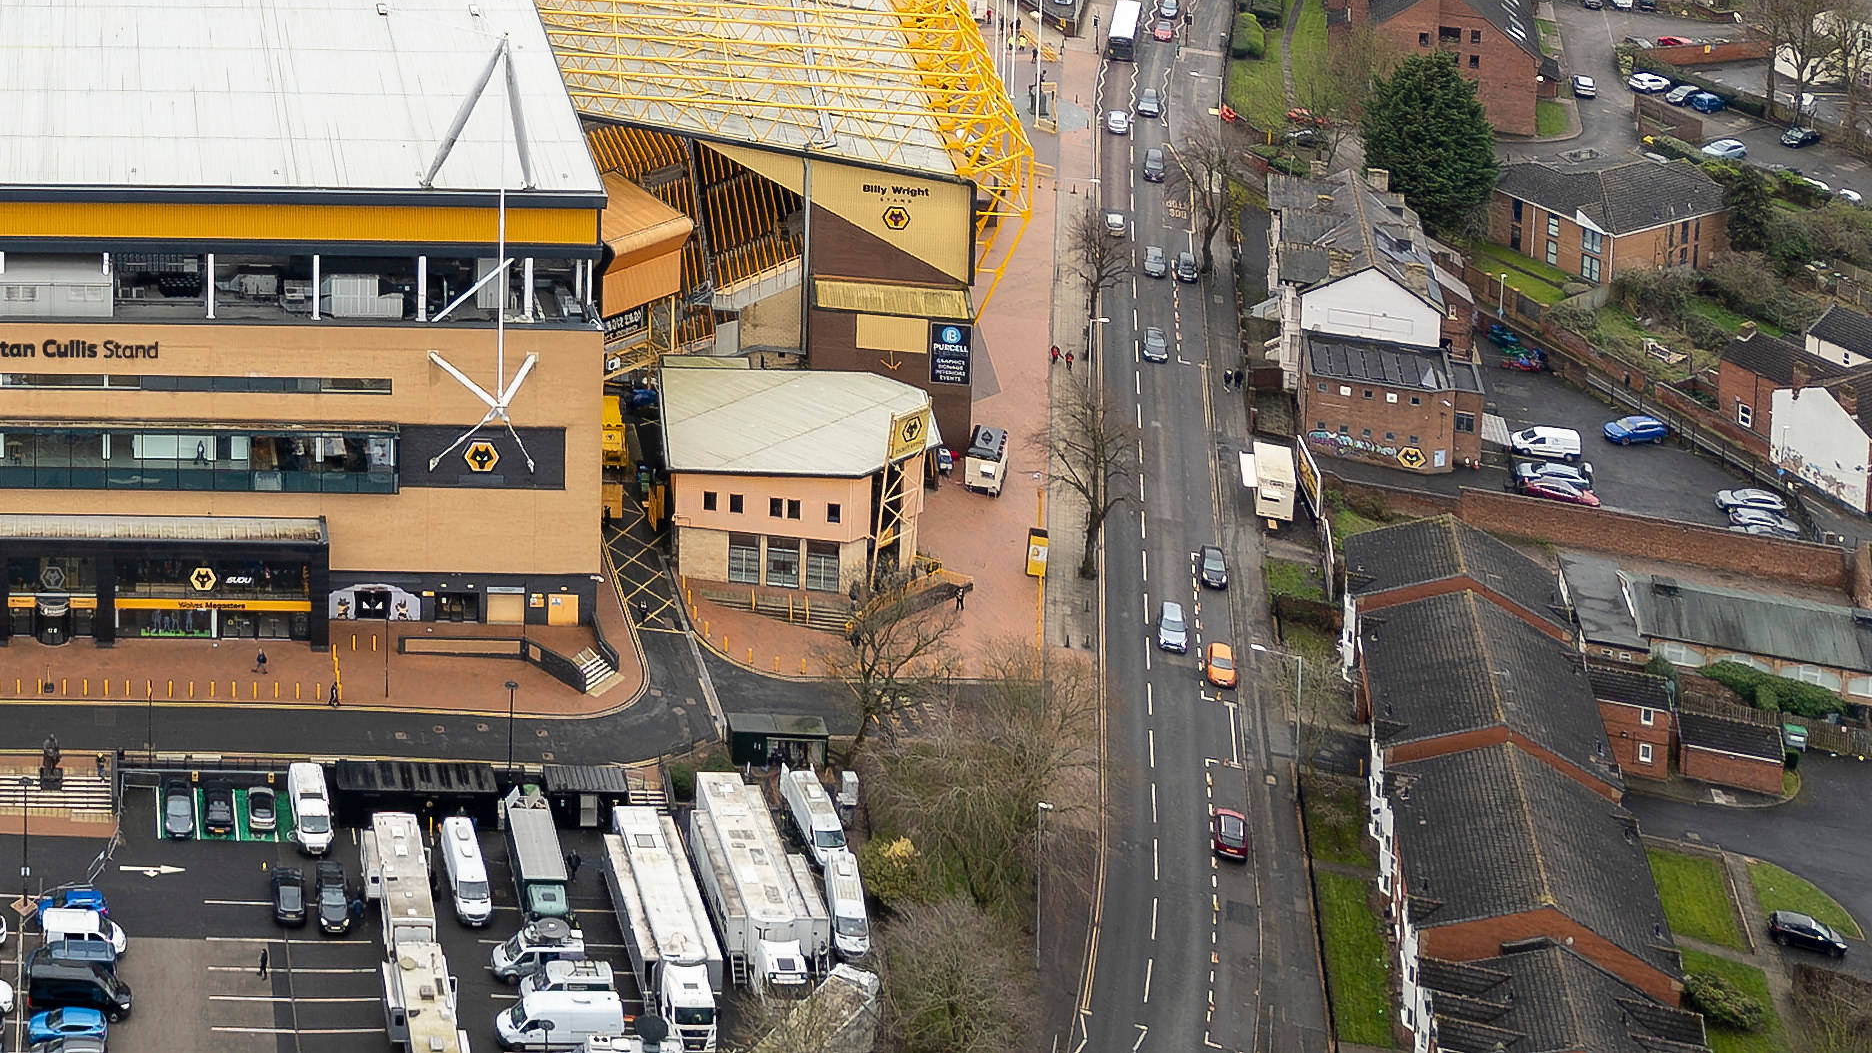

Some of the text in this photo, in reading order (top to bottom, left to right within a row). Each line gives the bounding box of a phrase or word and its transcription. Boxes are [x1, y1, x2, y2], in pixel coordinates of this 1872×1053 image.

[863, 184, 929, 197] Billy Wright
[42, 339, 97, 359] Cullis
[103, 340, 159, 359] Stand
[933, 343, 968, 353] PURCELL
[178, 601, 203, 609] Wolves
